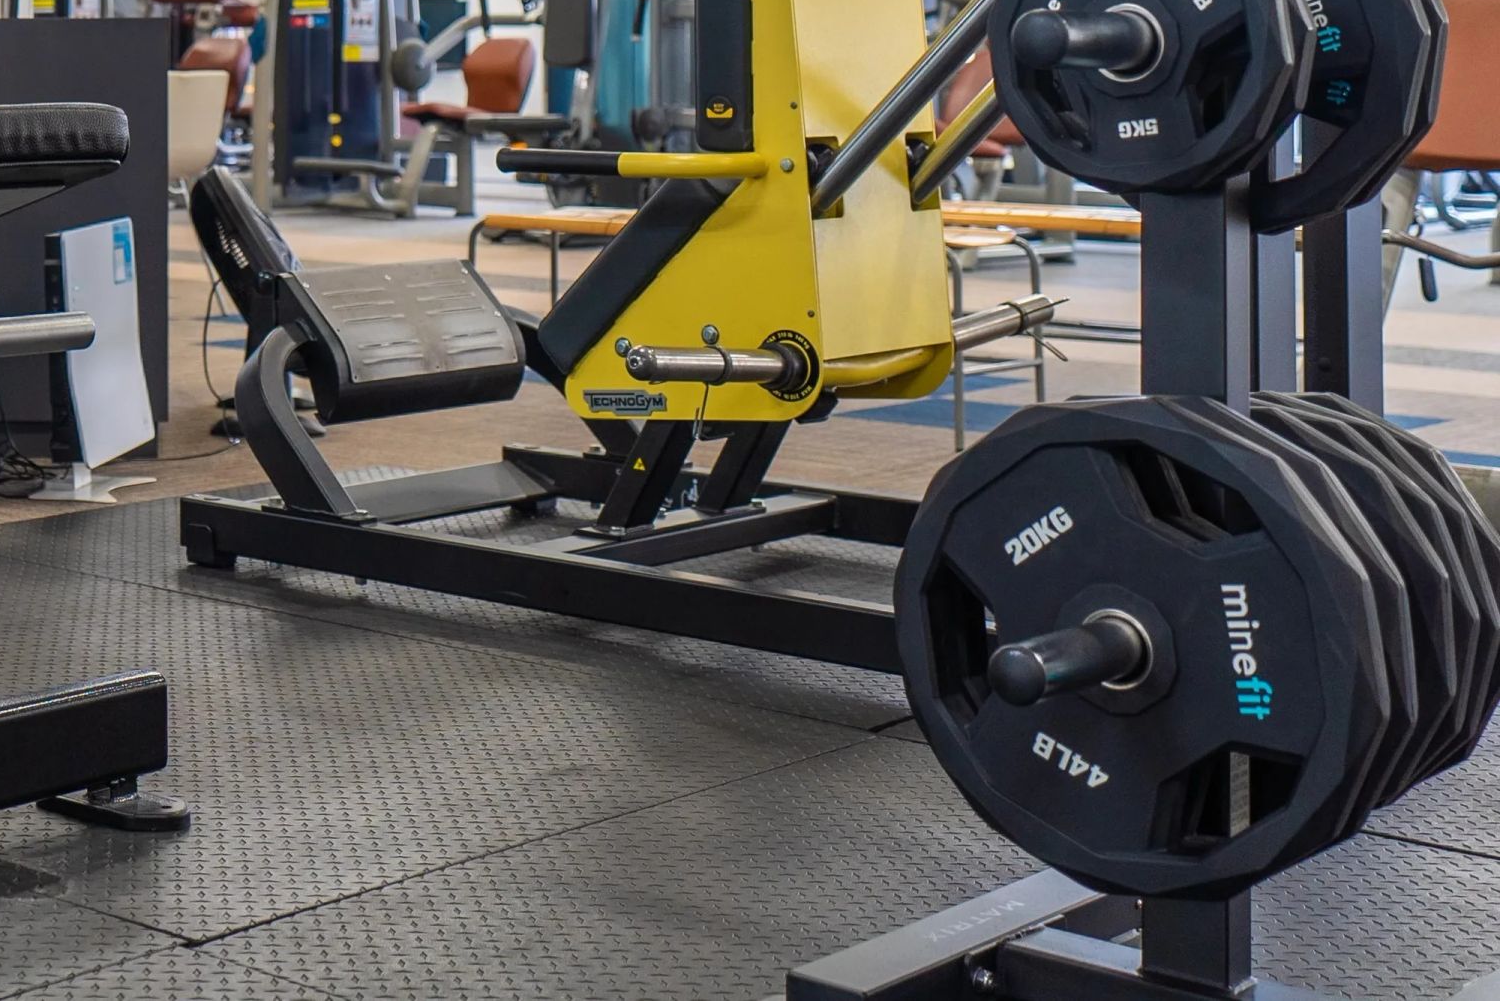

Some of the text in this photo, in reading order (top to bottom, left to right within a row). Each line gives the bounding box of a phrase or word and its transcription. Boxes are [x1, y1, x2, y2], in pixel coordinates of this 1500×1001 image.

[1118, 117, 1159, 139] 5KG
[1004, 506, 1074, 566] 20KG
[1220, 584, 1273, 720] minefit
[1032, 732, 1109, 788] 44LB
[928, 900, 1025, 943] MATRIX
